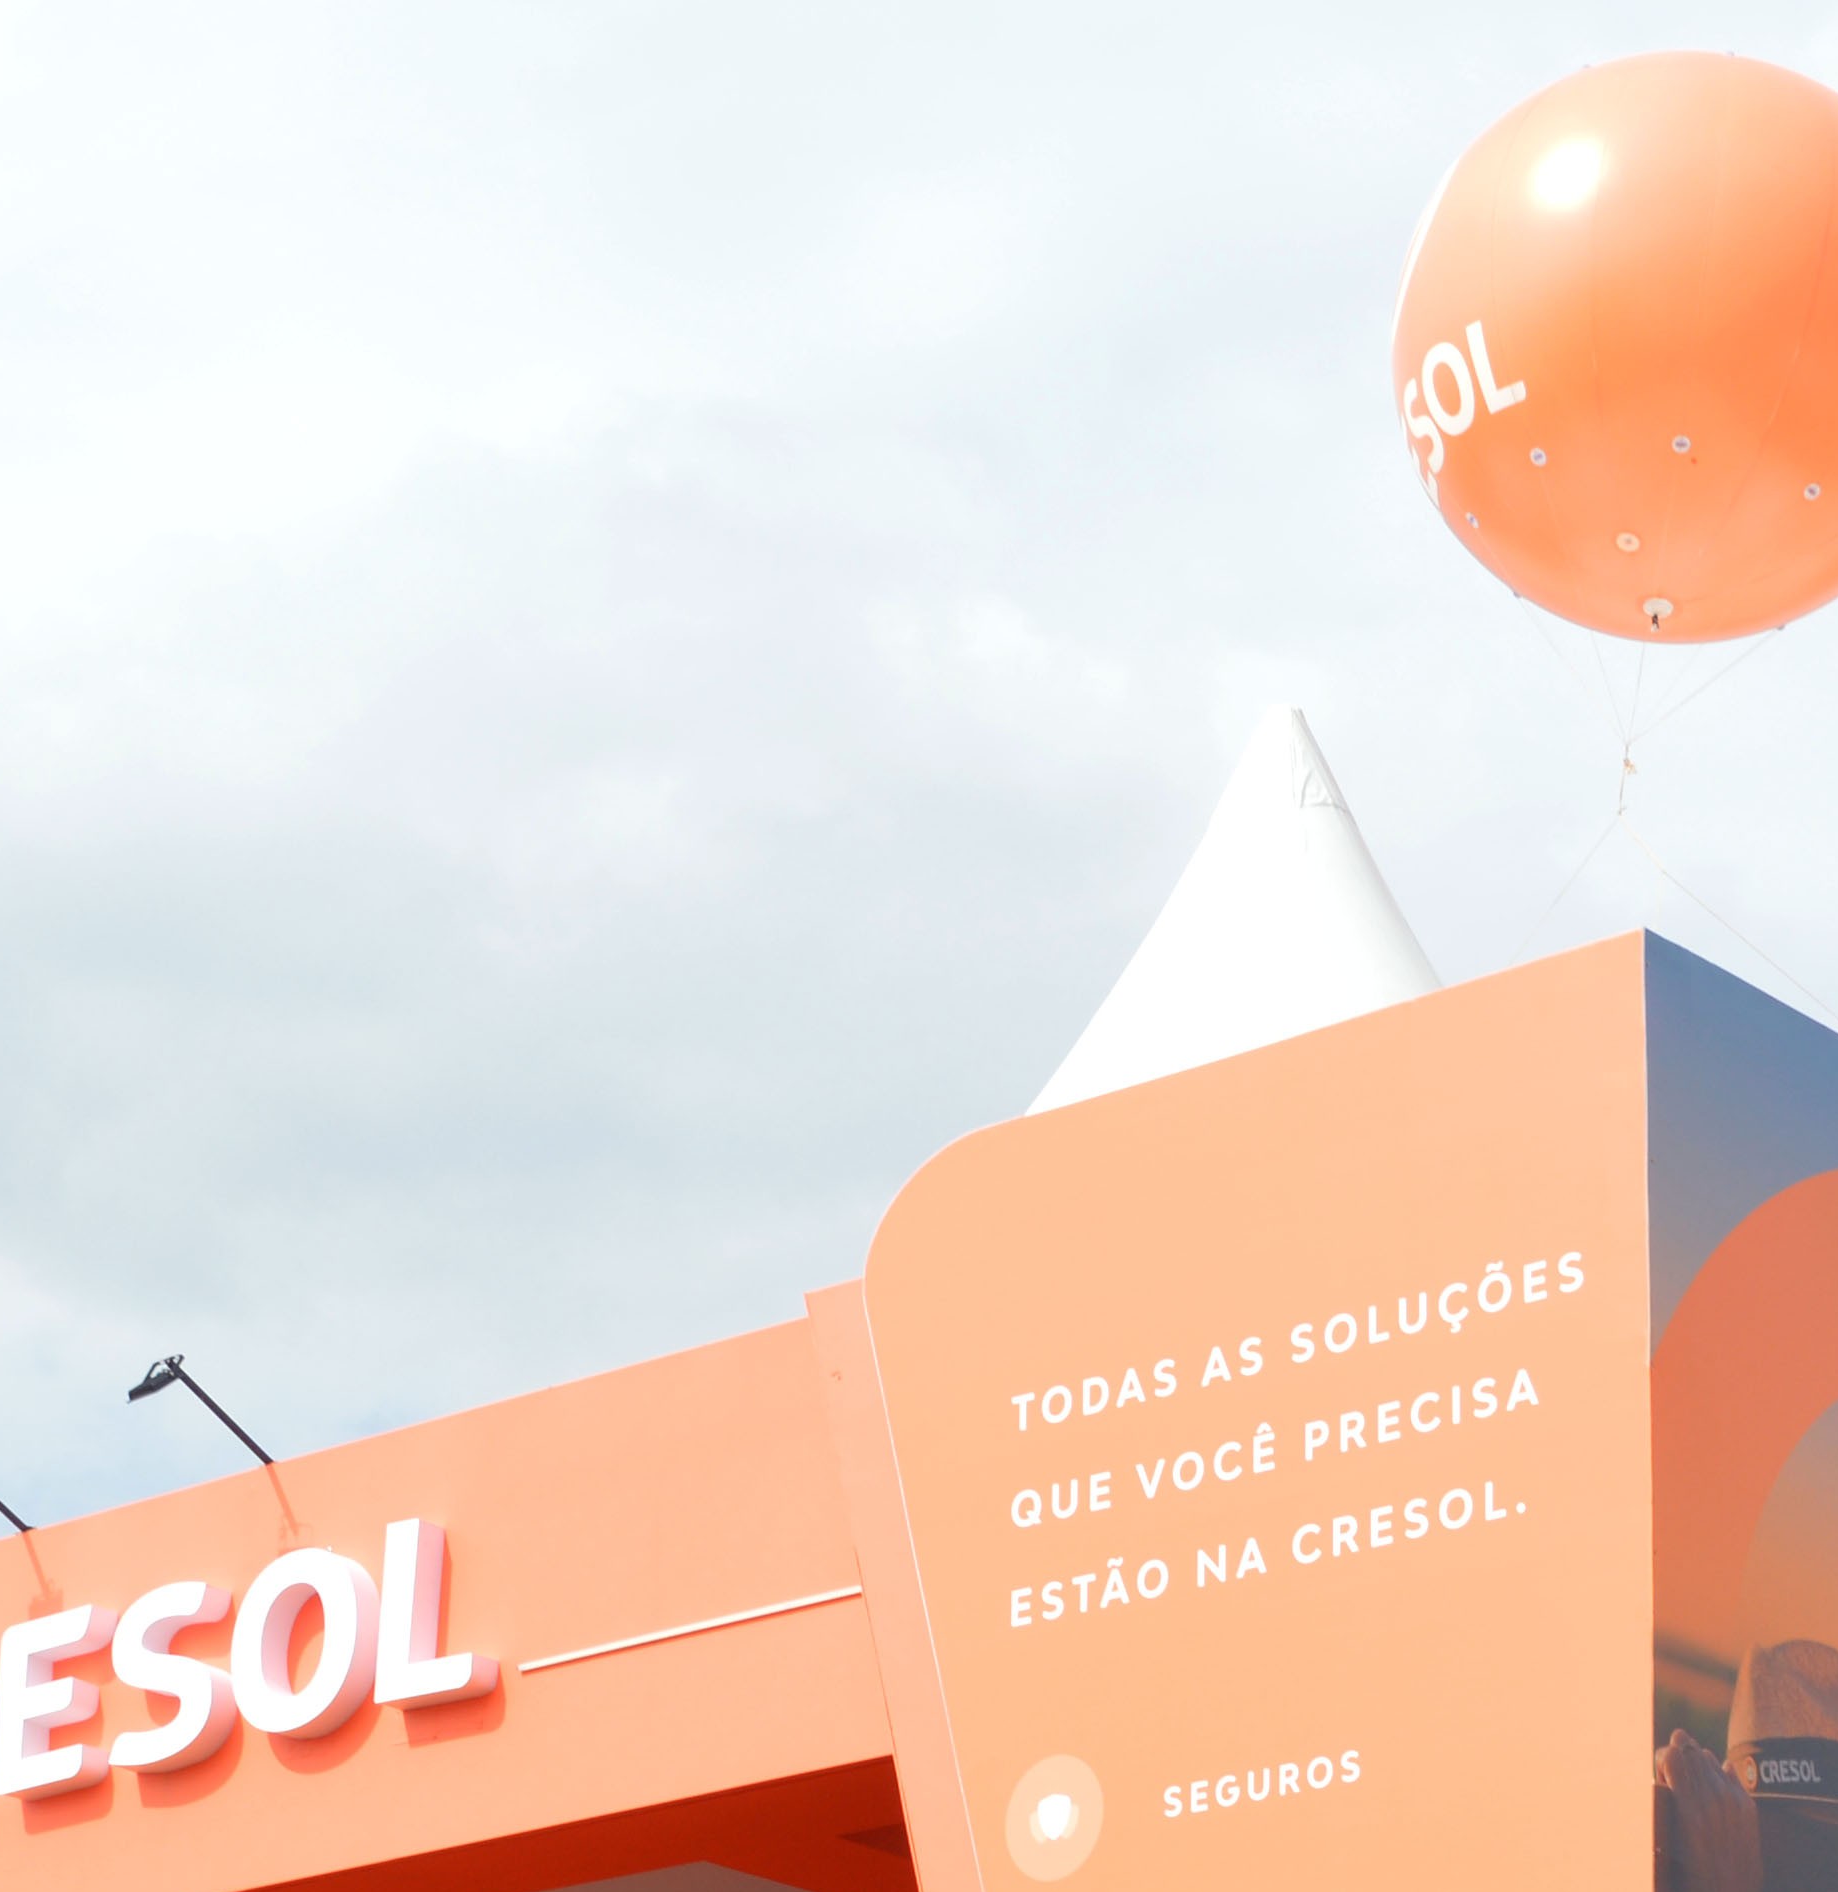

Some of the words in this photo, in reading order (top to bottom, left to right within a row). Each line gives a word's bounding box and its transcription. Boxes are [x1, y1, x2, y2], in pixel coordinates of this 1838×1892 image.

[1402, 320, 1527, 505] SOL
[1011, 1359, 1178, 1431] TODAS
[1201, 1337, 1264, 1387] AS
[1290, 1252, 1585, 1363] SOLUÇÕES
[1011, 1472, 1112, 1528] QUE
[1136, 1421, 1276, 1499] VOCÊ
[1305, 1368, 1539, 1460] PRECISA
[1010, 1557, 1169, 1628] ESTÃO
[1196, 1537, 1266, 1587] NA
[1291, 1481, 1526, 1564] CRESOL.
[1163, 1750, 1361, 1818] SEGUROS
[1760, 1759, 1821, 1784] CRESOL
